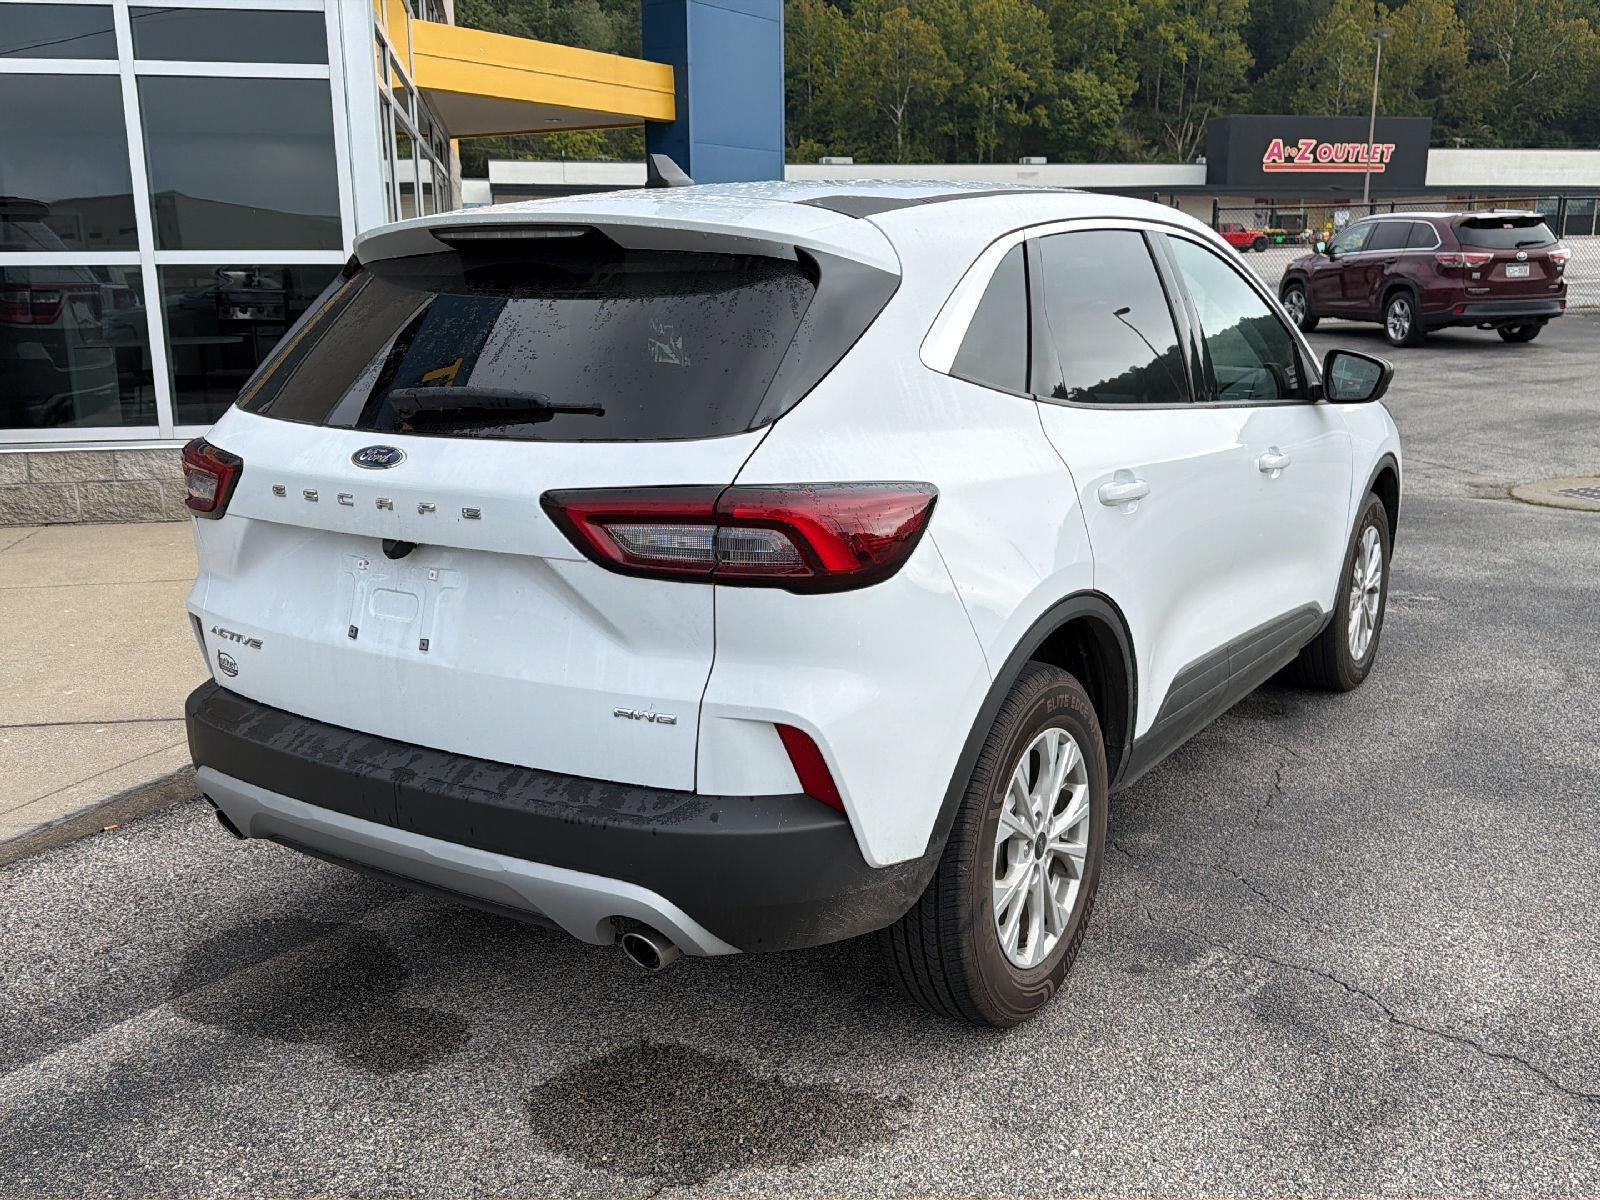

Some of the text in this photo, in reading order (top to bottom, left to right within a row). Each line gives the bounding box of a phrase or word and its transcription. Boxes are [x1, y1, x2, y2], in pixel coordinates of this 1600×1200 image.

[1317, 143, 1395, 163] OUTLET
[272, 484, 481, 520] ESCAPE
[211, 625, 263, 650] ACTIVE
[1046, 693, 1070, 714] ELITE
[613, 706, 677, 725] AWD
